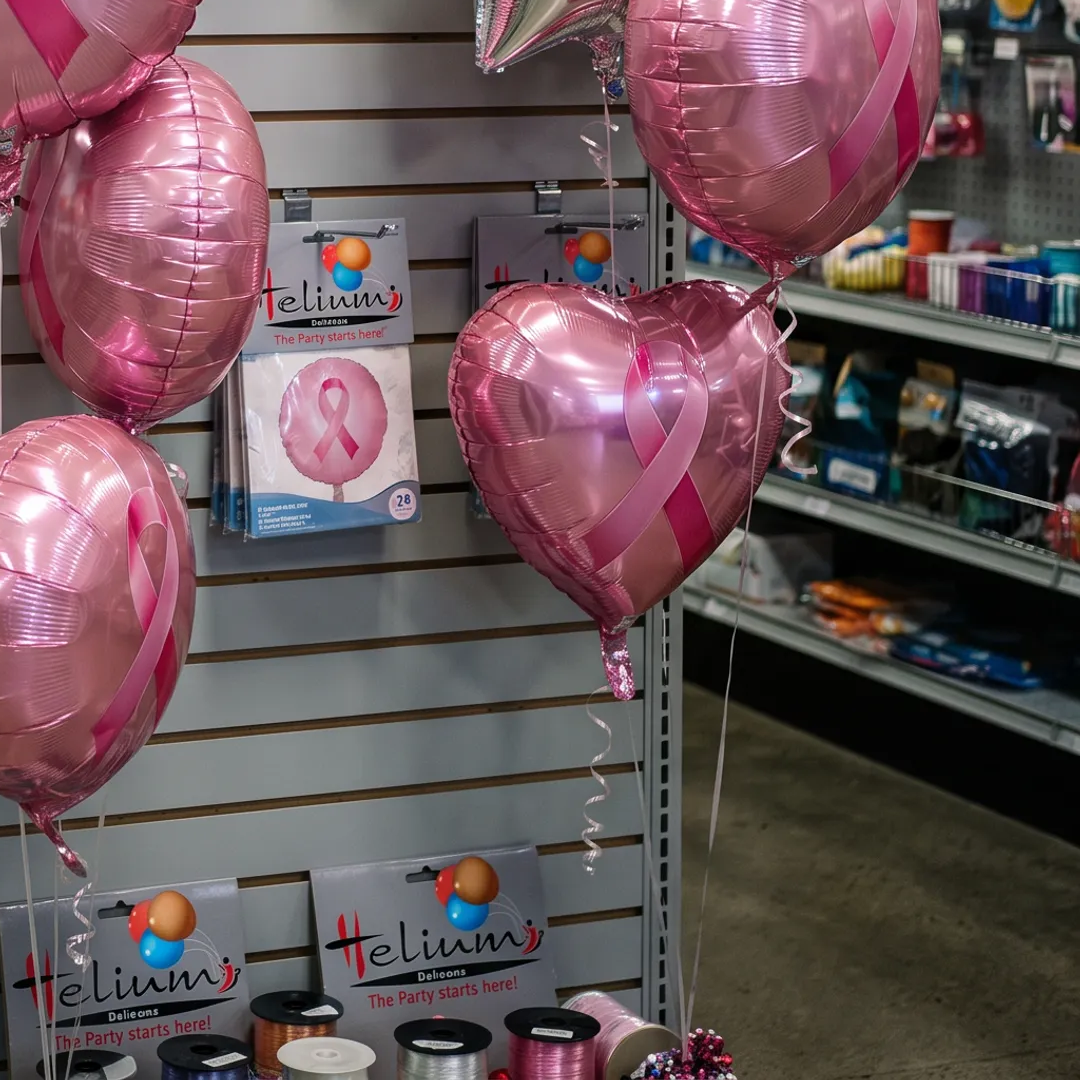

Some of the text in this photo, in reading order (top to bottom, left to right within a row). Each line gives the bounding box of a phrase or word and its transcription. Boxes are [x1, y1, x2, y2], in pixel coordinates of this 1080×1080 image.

[274, 328, 384, 345] The Party starts here!
[396, 493, 411, 508] 28
[324, 909, 526, 980] Helium
[368, 975, 518, 1010] The Party starts here!
[55, 1014, 212, 1051] The Party starts here!
